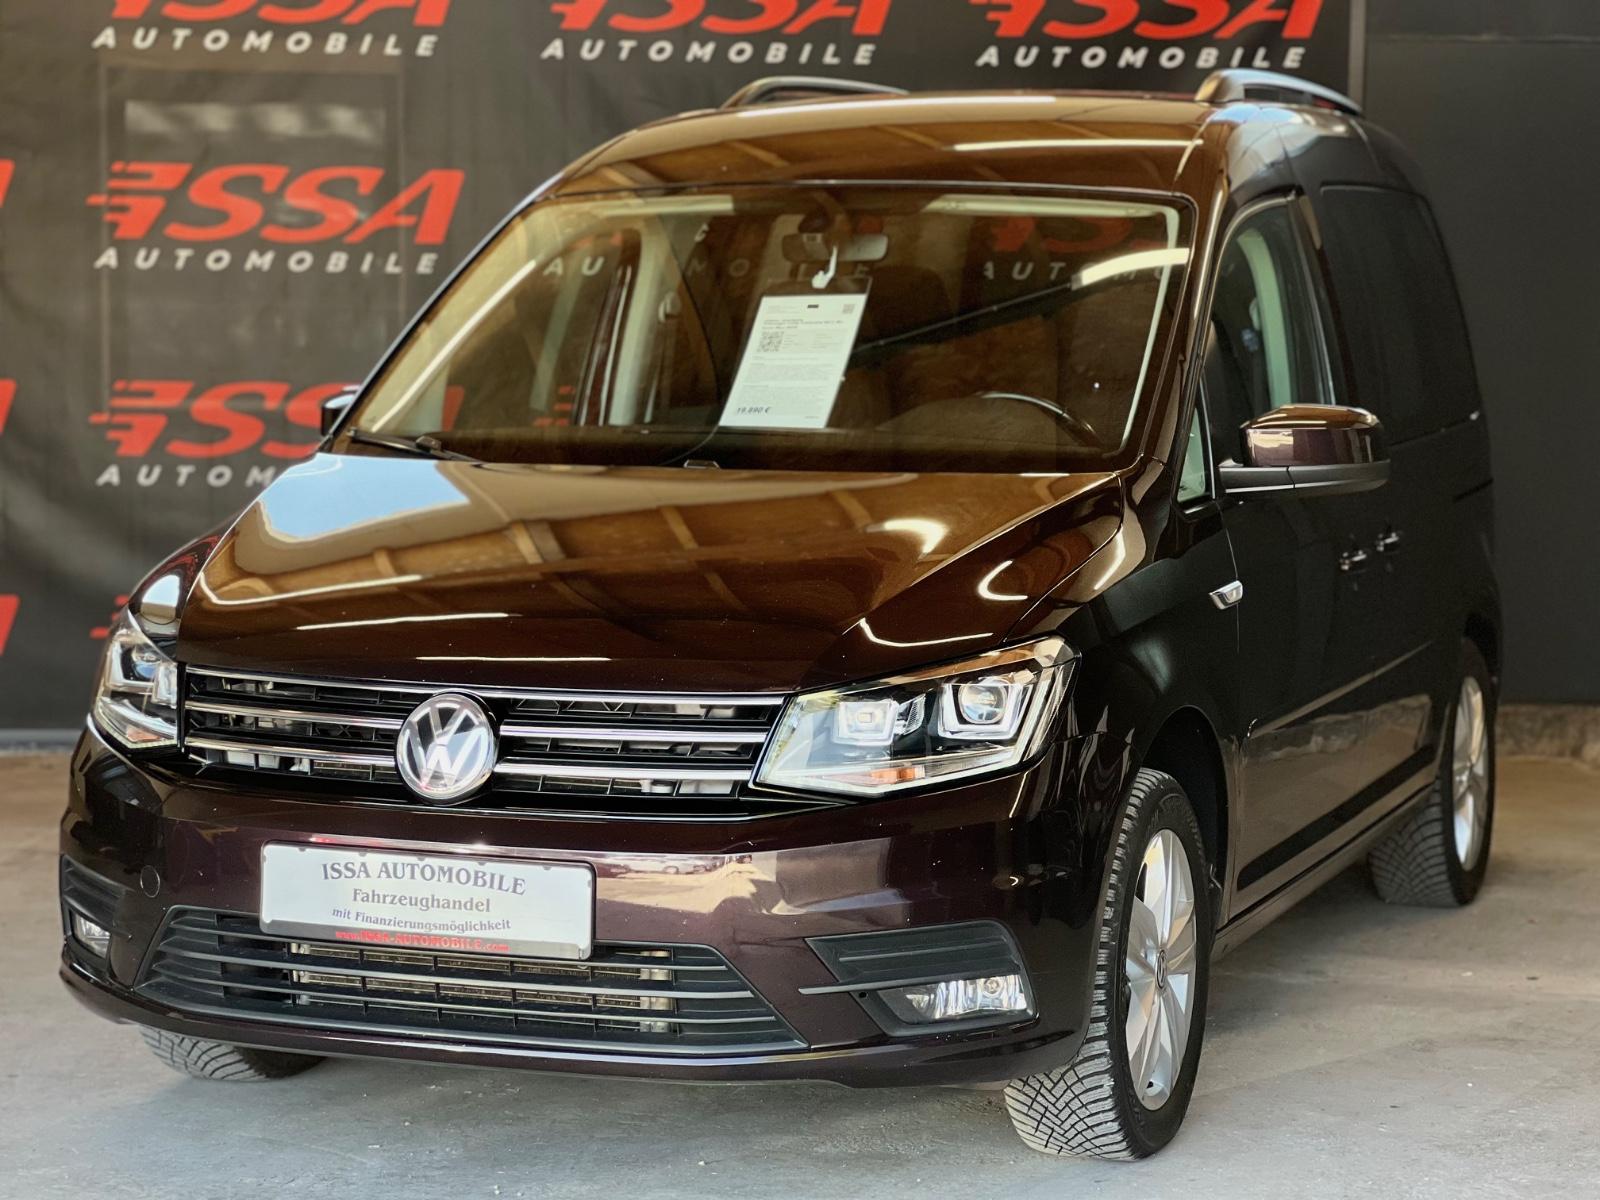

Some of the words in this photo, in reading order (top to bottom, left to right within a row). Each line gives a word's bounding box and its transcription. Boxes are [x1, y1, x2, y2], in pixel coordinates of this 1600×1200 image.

[92, 26, 438, 57] AUTOMOBILE
[540, 38, 877, 65] AUTOMOBILE
[975, 46, 1306, 69] AUTOMOBILE
[94, 246, 438, 275] AUTOMOBILE
[322, 861, 371, 881] ISSA
[377, 861, 526, 896] AUTOMOBILE
[353, 887, 491, 913] Fahrzeughandel
[332, 907, 352, 920] mit
[355, 910, 511, 934] Finanzierungsmöglichkeit
